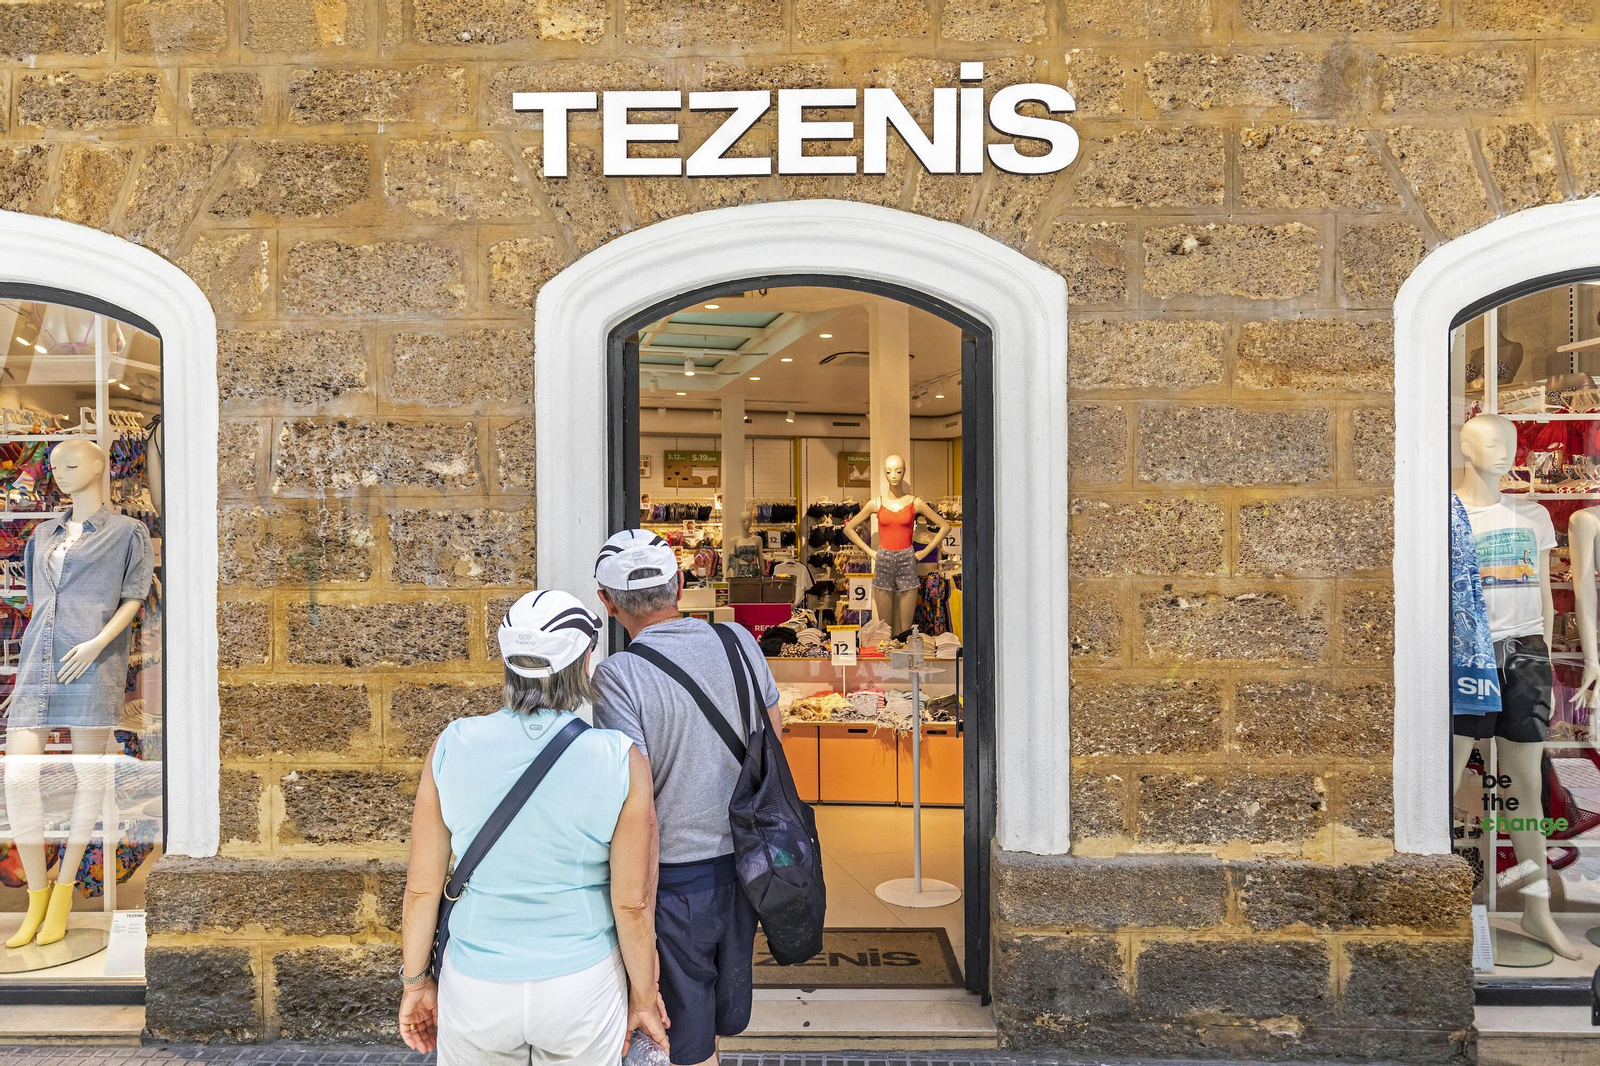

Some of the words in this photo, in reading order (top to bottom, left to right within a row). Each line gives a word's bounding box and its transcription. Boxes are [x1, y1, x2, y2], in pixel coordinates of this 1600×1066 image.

[1481, 771, 1512, 789] be
[1482, 793, 1519, 811] the
[1481, 813, 1568, 836] change
